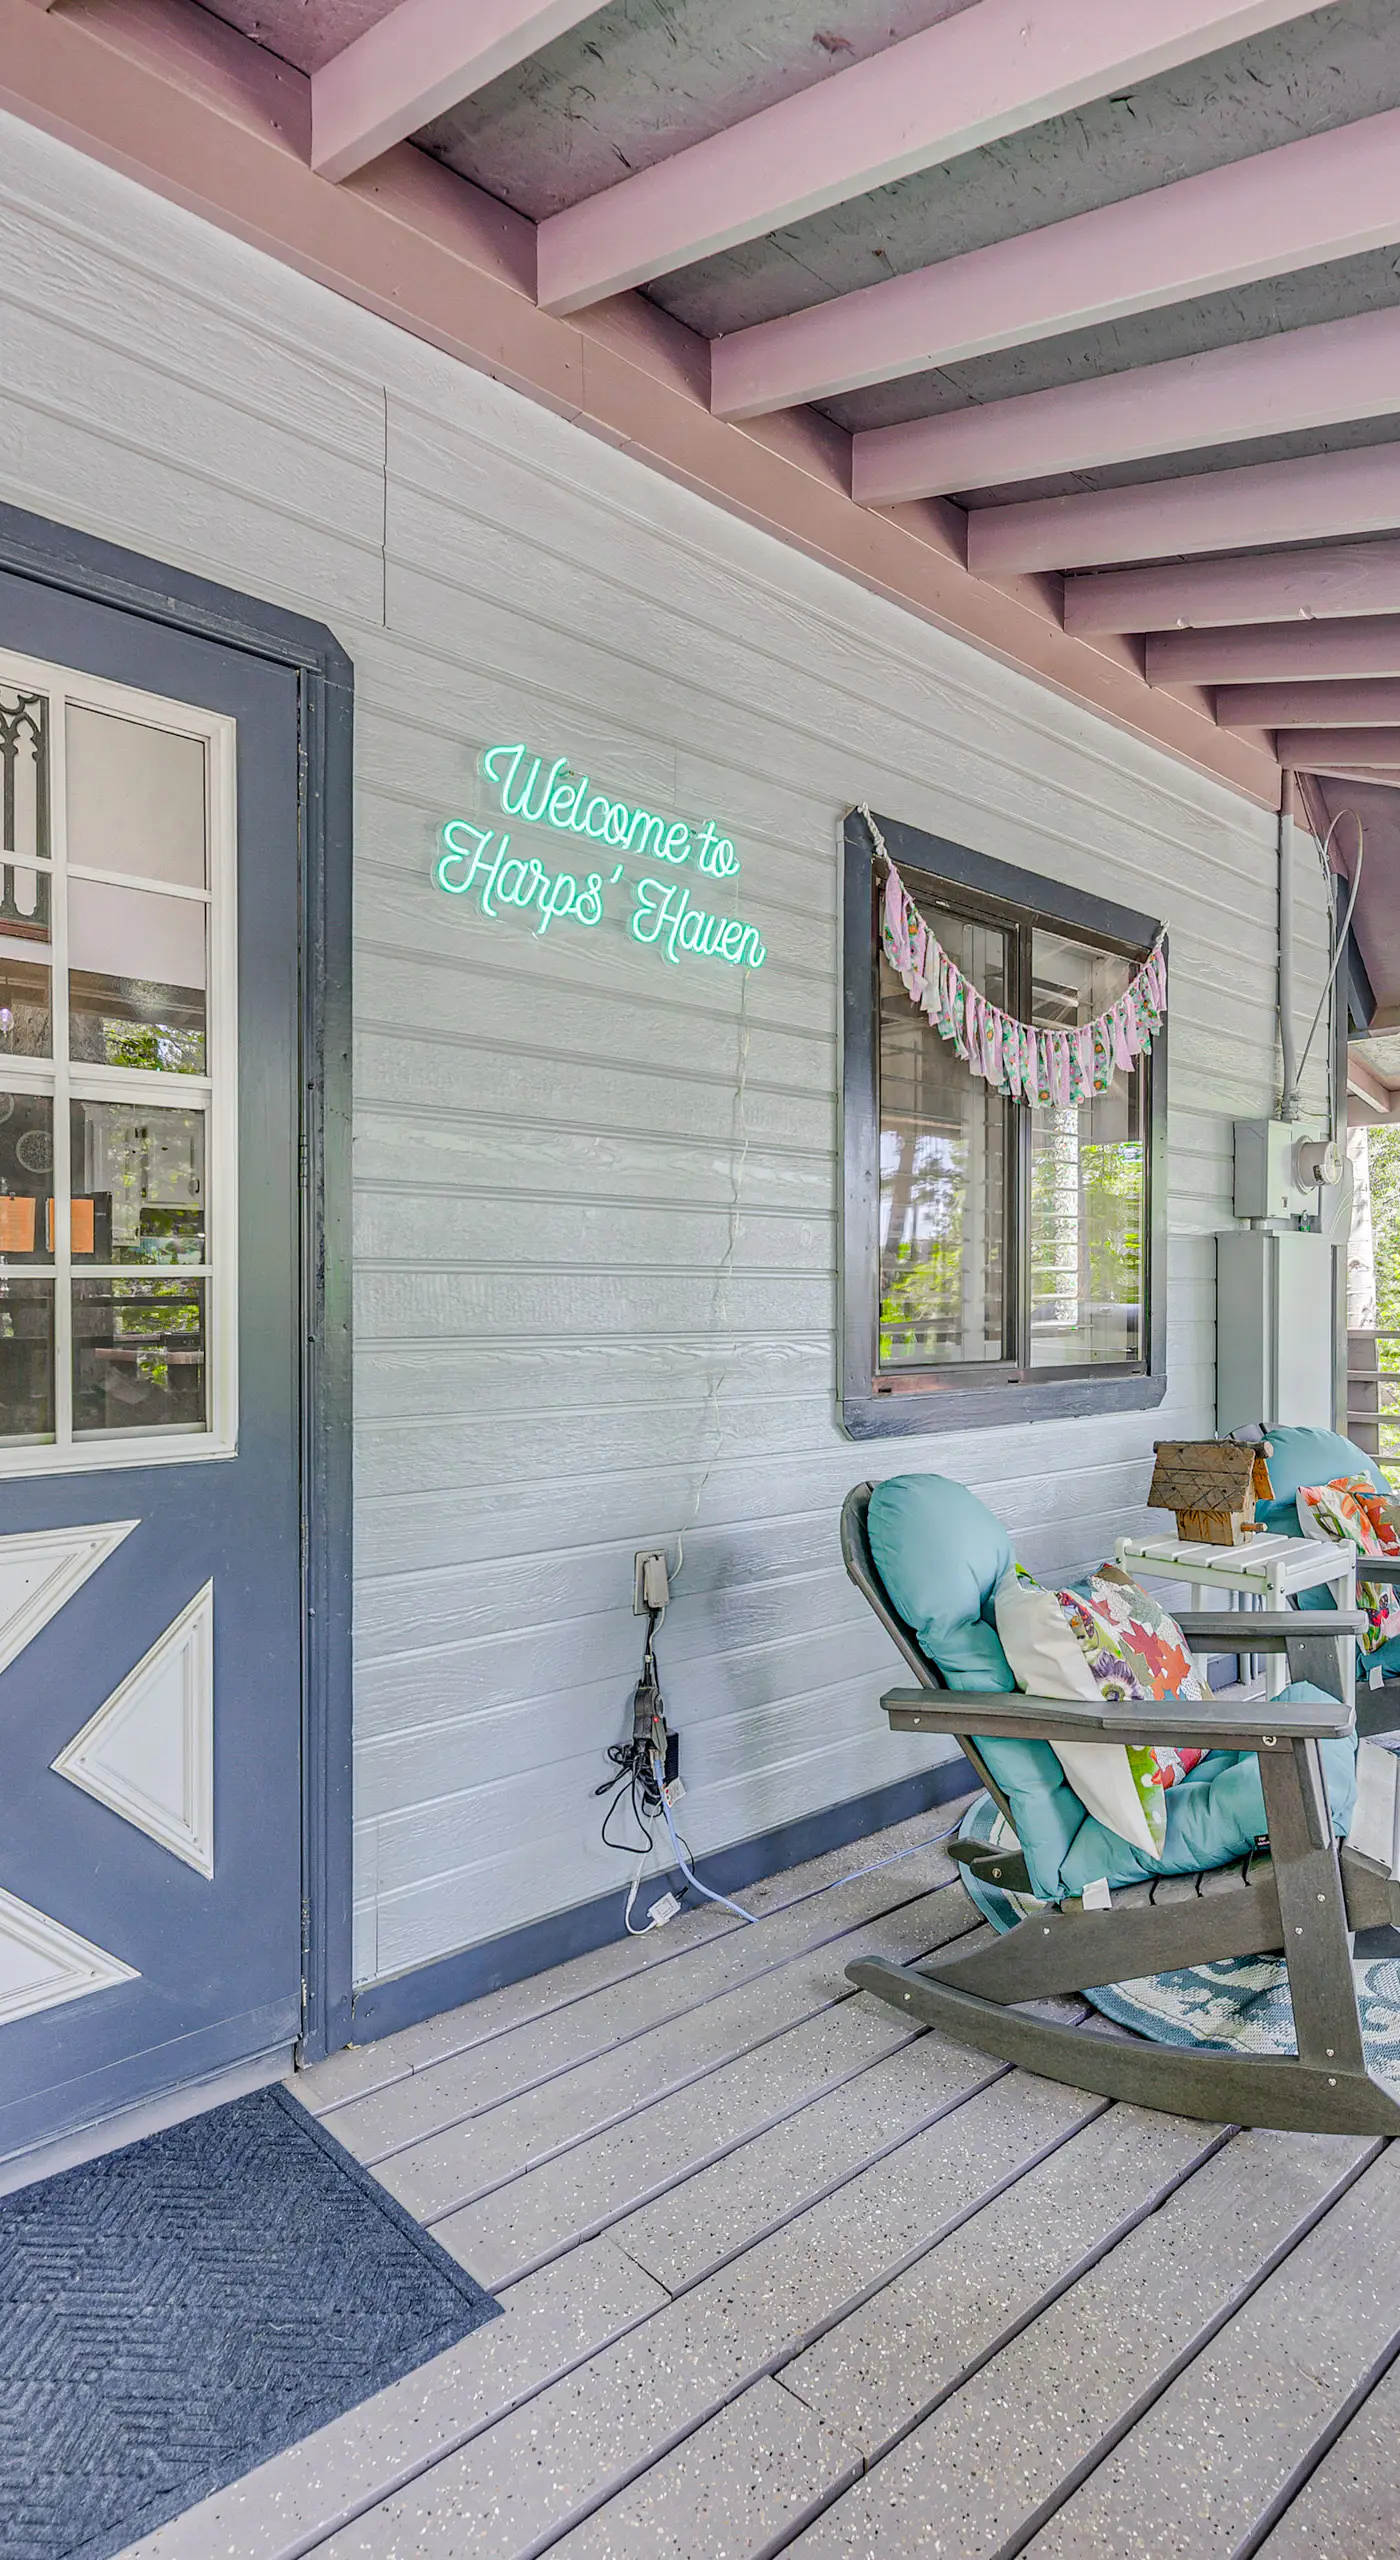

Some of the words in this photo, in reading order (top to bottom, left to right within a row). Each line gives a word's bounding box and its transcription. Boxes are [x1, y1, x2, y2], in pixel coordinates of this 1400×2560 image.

[483, 744, 692, 863] Welcome
[697, 819, 741, 878] to
[631, 877, 767, 965] Haven
